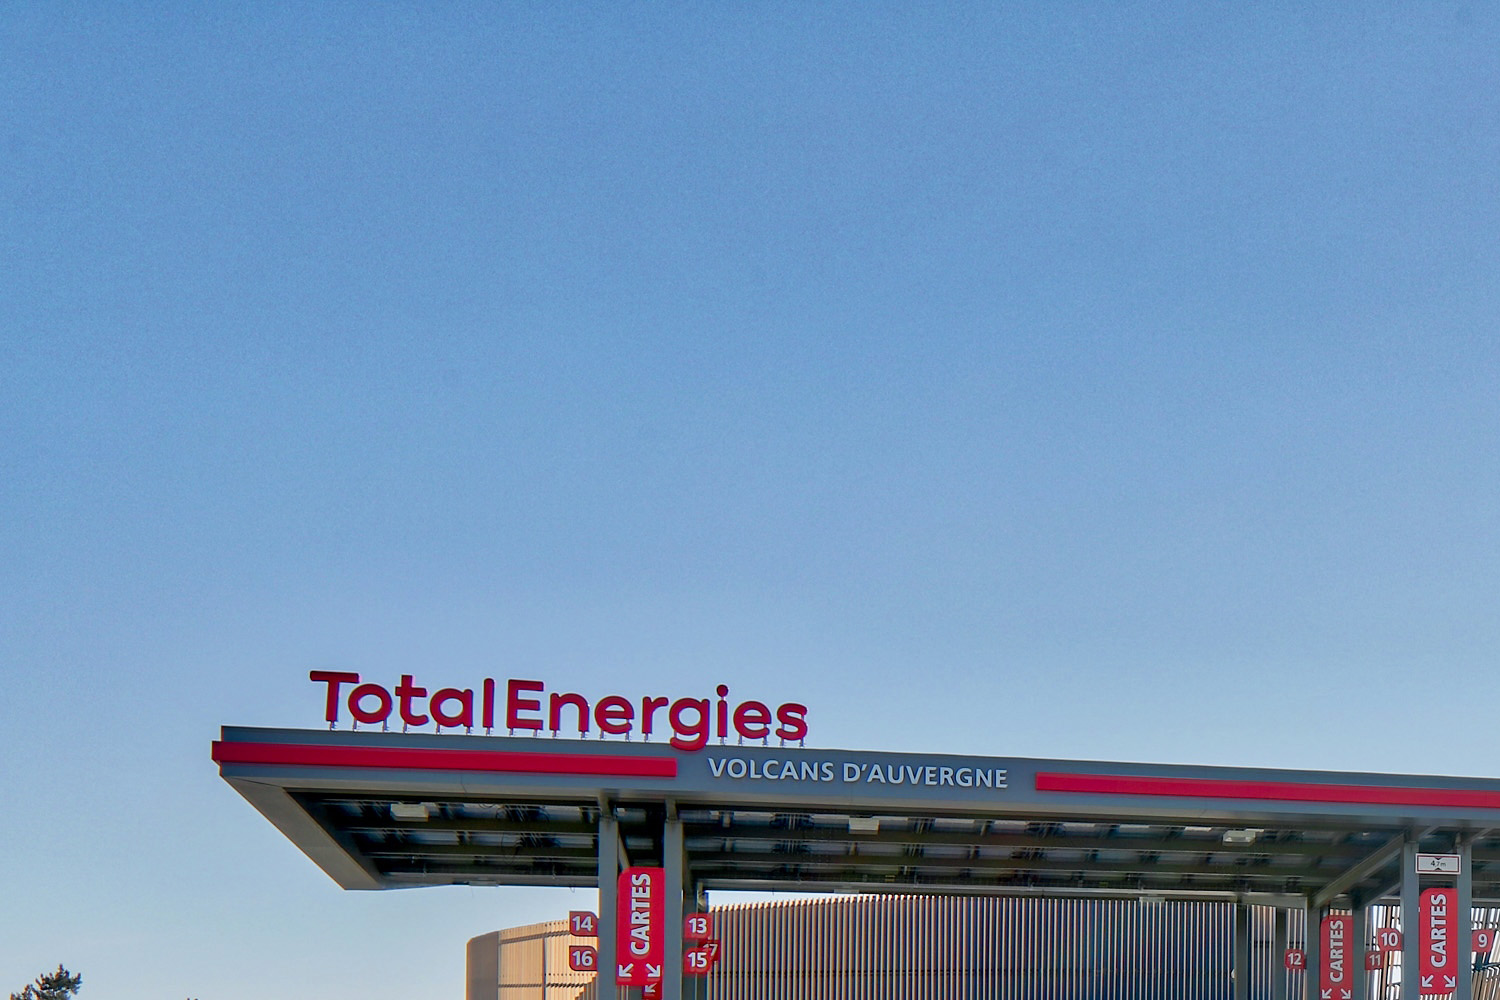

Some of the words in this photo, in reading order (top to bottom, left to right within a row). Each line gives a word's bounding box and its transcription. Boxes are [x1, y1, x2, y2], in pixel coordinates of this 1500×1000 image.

[310, 670, 808, 751] TotalEnergies
[707, 757, 834, 782] VOLCANS
[843, 763, 1008, 789] D'AUVERGNE
[631, 873, 651, 955] CARTES
[572, 916, 593, 932] 14
[688, 918, 707, 934] 13
[1430, 894, 1447, 968] CARTES
[1381, 932, 1398, 947] 10
[1478, 934, 1488, 948] 9
[572, 951, 593, 966] 16
[1288, 953, 1302, 966] 12
[1329, 920, 1344, 983] CARTES
[688, 952, 707, 968] 15
[1369, 954, 1381, 967] 11
